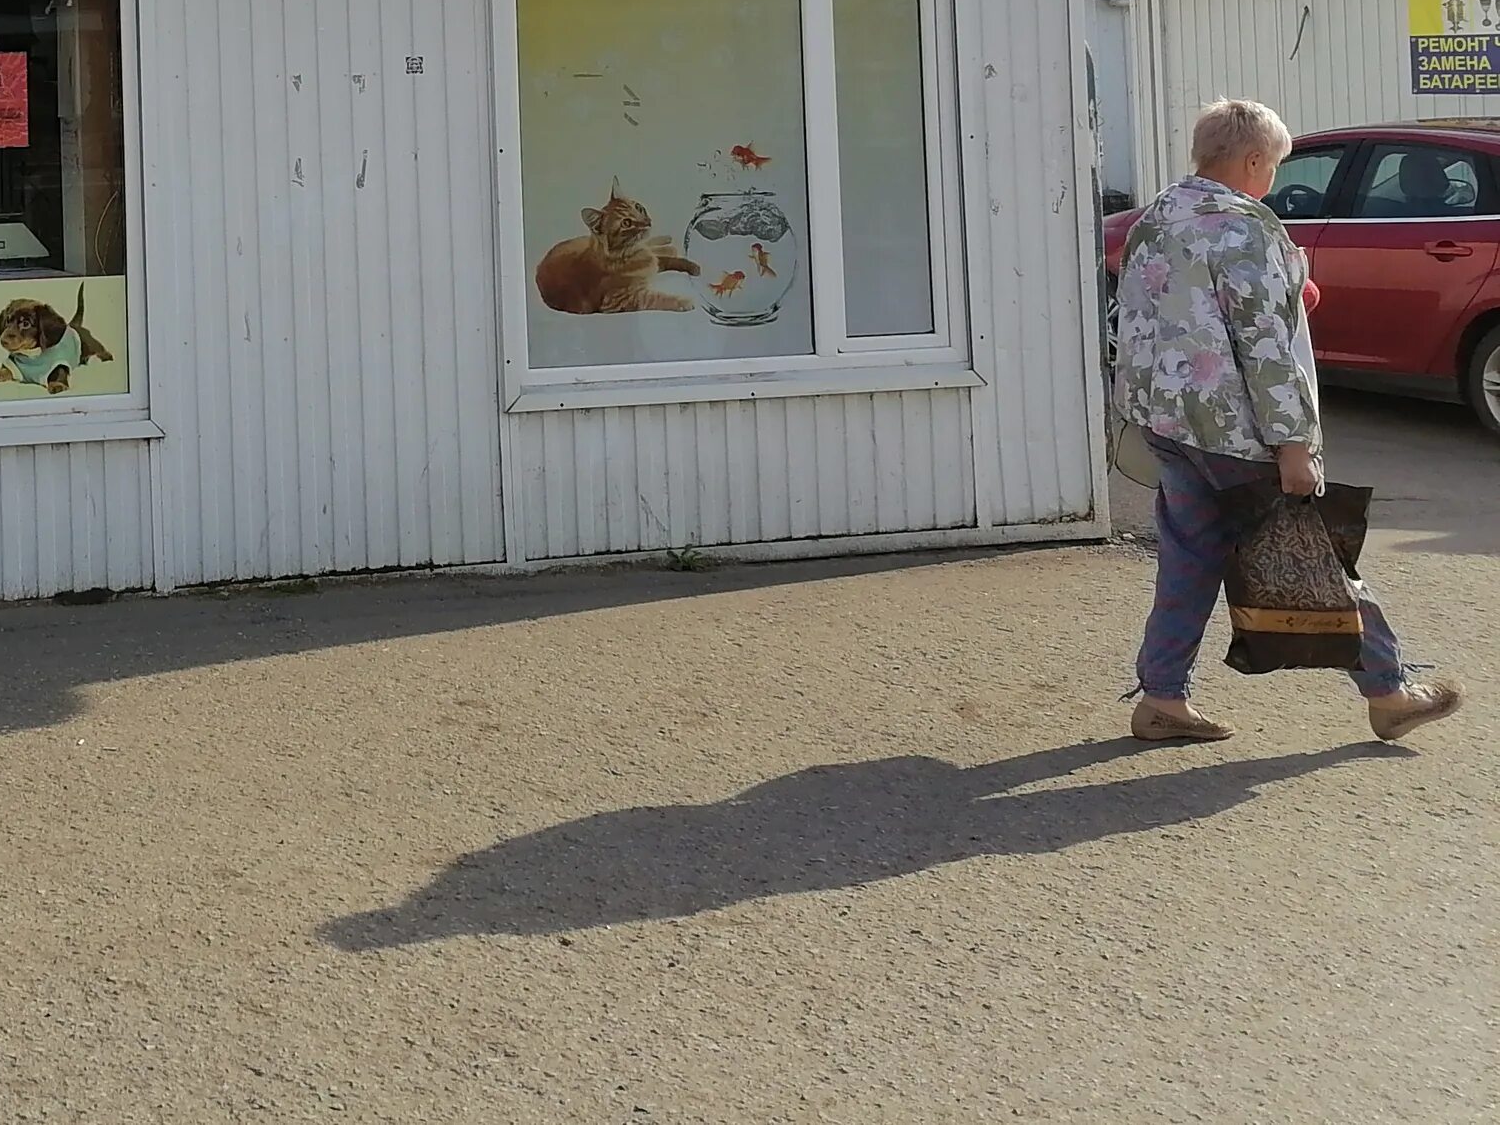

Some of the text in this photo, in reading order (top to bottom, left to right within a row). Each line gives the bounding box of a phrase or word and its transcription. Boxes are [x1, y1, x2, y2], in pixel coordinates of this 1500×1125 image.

[1418, 36, 1490, 53] РЕМОНТ
[1418, 55, 1492, 71] ЗАМЕНА
[1419, 73, 1500, 89] БАТАРЕЕ
